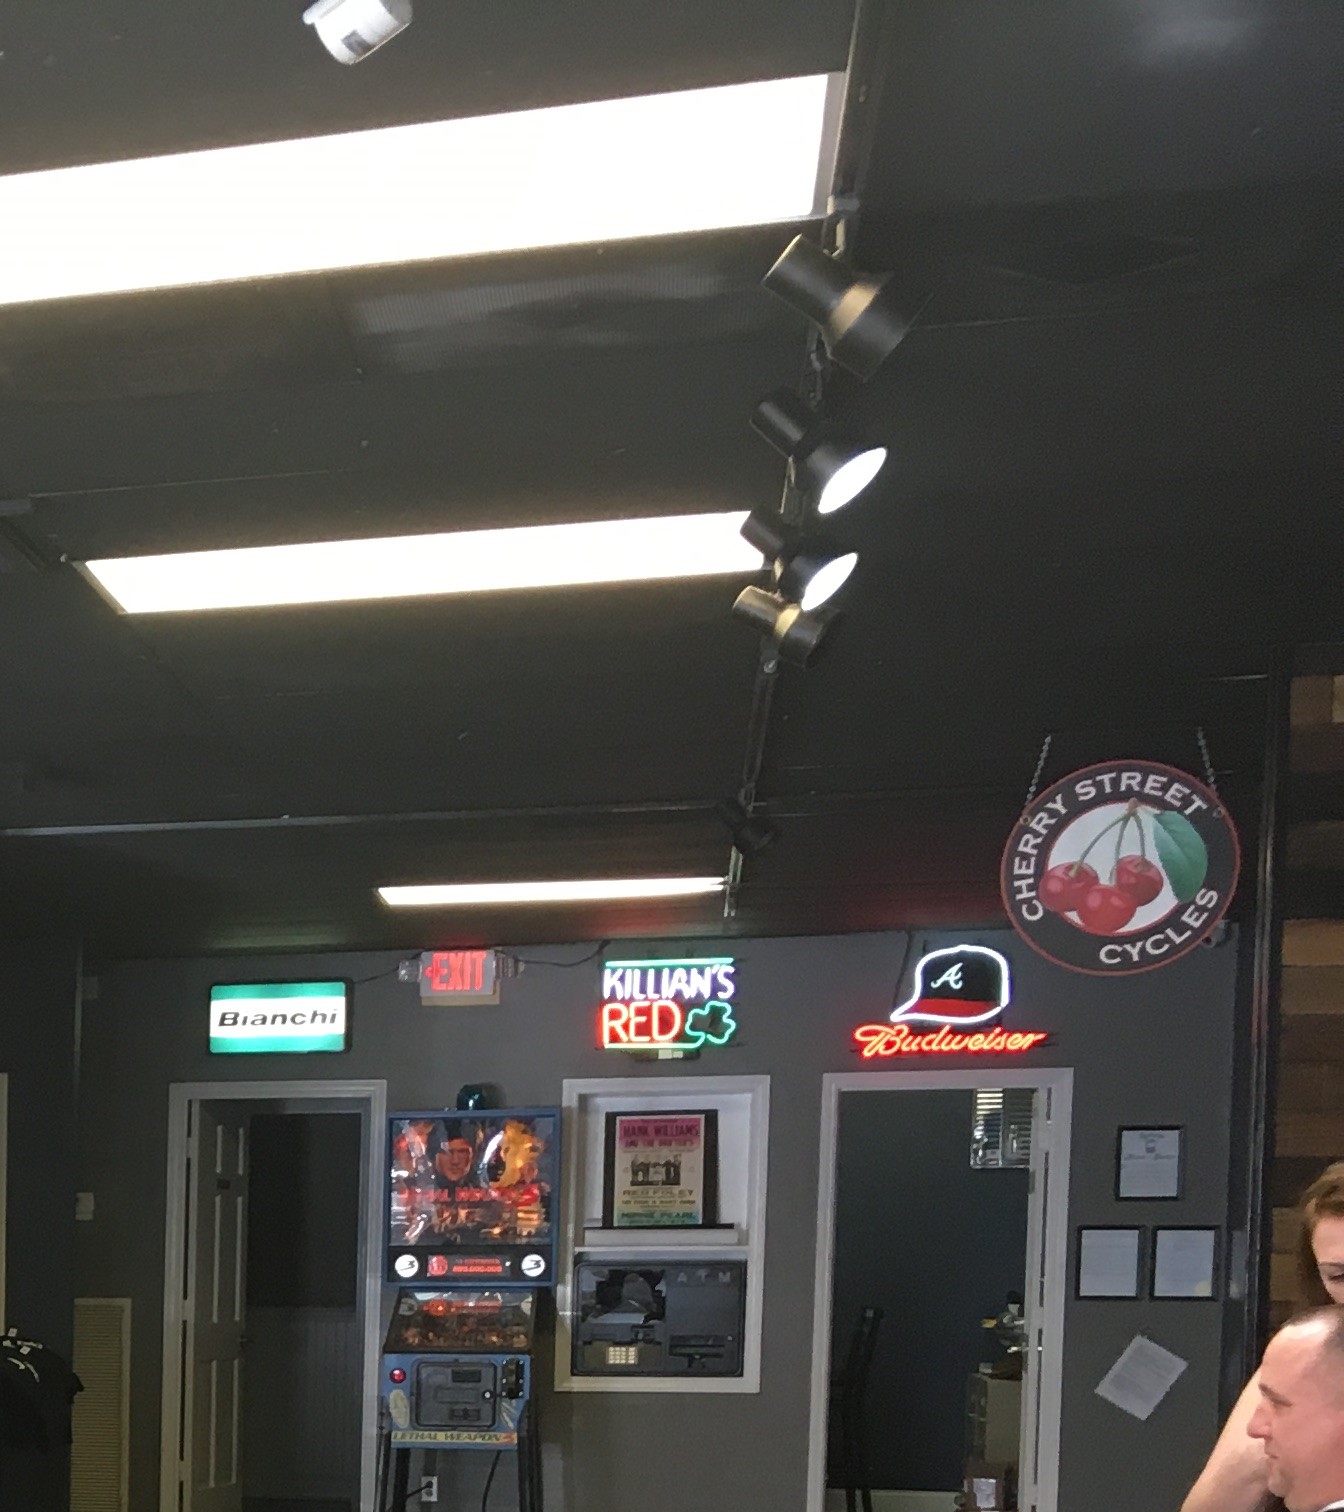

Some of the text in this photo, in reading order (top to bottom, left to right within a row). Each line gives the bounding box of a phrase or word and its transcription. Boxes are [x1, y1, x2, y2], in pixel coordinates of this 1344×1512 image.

[1014, 771, 1208, 922] CHERRY STREET
[1099, 888, 1218, 964] CYCLES
[431, 951, 487, 991] EXIT
[603, 964, 736, 1000] KILLIAN'S
[218, 1009, 338, 1027] Bianchi
[602, 1000, 682, 1044] RED
[854, 1023, 1048, 1057] Budweiser
